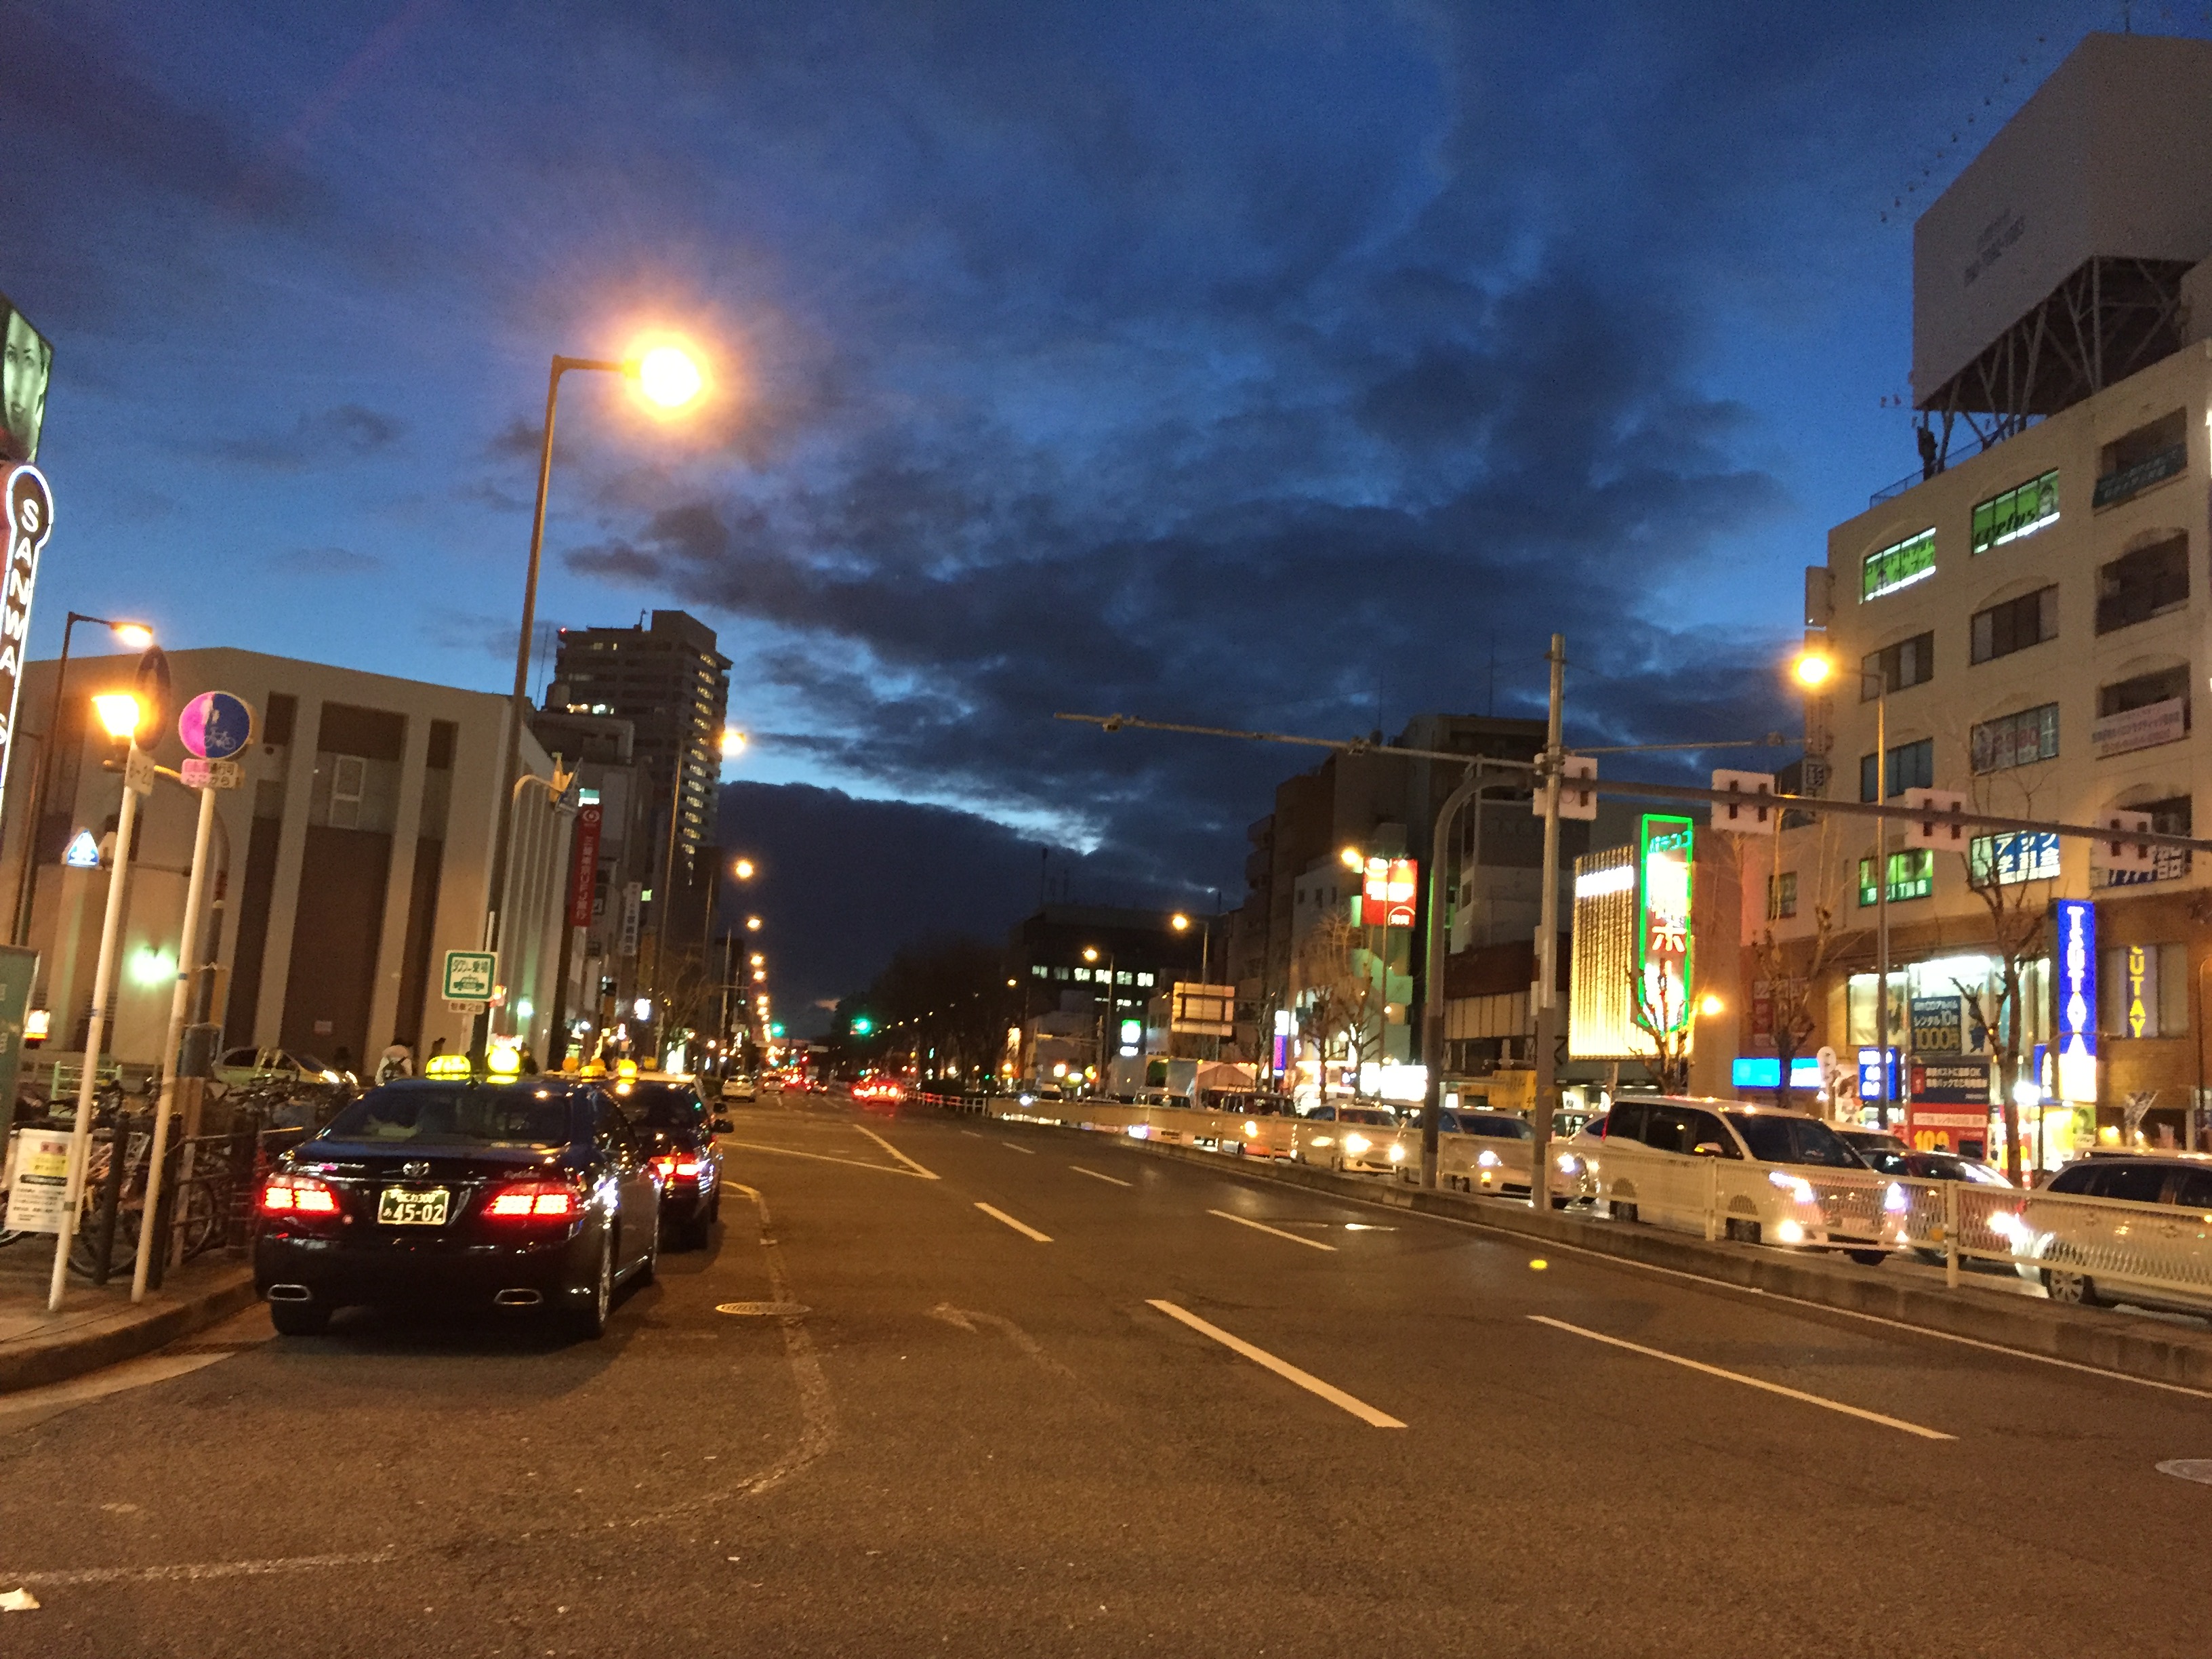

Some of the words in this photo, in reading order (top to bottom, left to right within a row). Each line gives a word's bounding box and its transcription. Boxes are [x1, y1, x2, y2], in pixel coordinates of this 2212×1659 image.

[0, 498, 39, 677] SANWA
[2067, 906, 2087, 1055] TSUTAYA
[392, 1204, 445, 1222] 45-02
